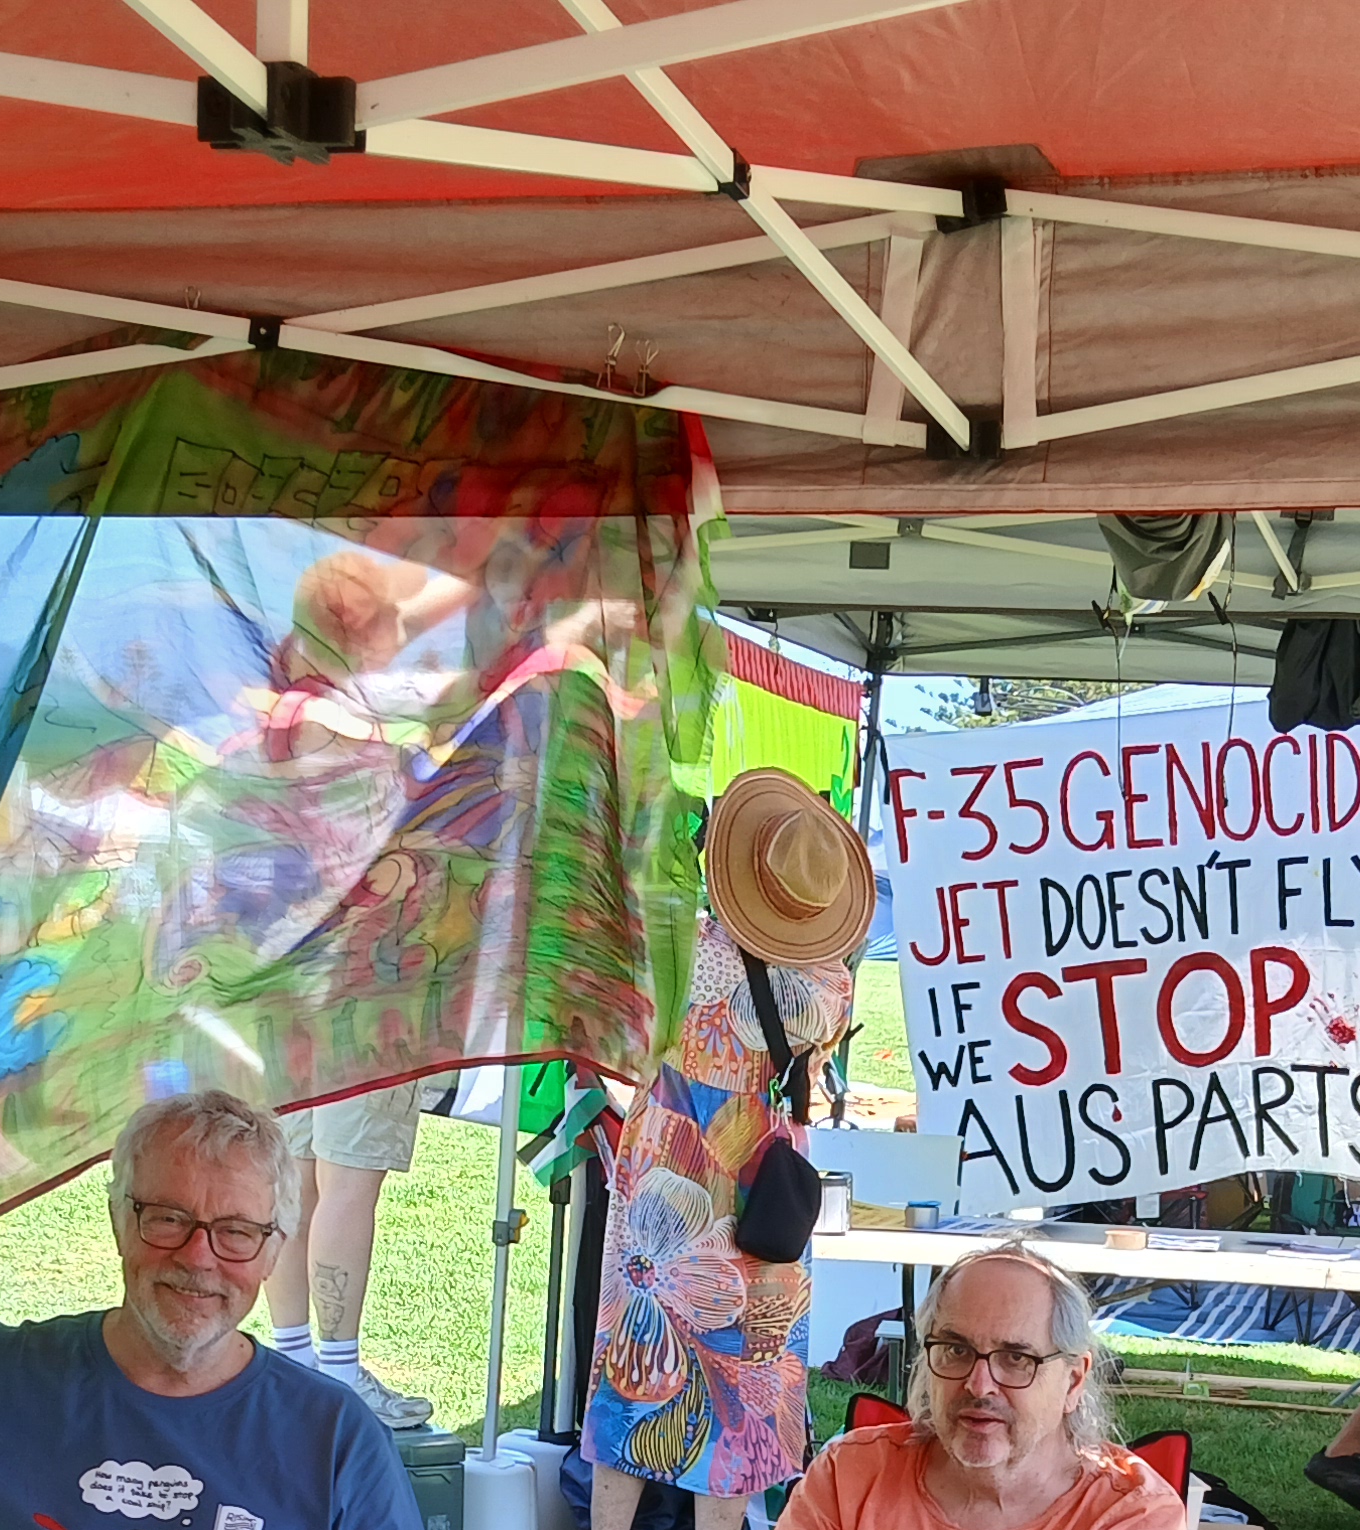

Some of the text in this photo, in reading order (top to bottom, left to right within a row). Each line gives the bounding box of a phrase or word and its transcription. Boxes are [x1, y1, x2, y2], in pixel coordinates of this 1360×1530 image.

[888, 758, 1050, 862] F-35
[910, 880, 1019, 966] JET
[1040, 850, 1250, 956] DOESN'T
[929, 982, 980, 1037] IF
[1002, 946, 1309, 1085] STOP
[918, 1040, 992, 1090] WE
[957, 1084, 1131, 1195] AUS
